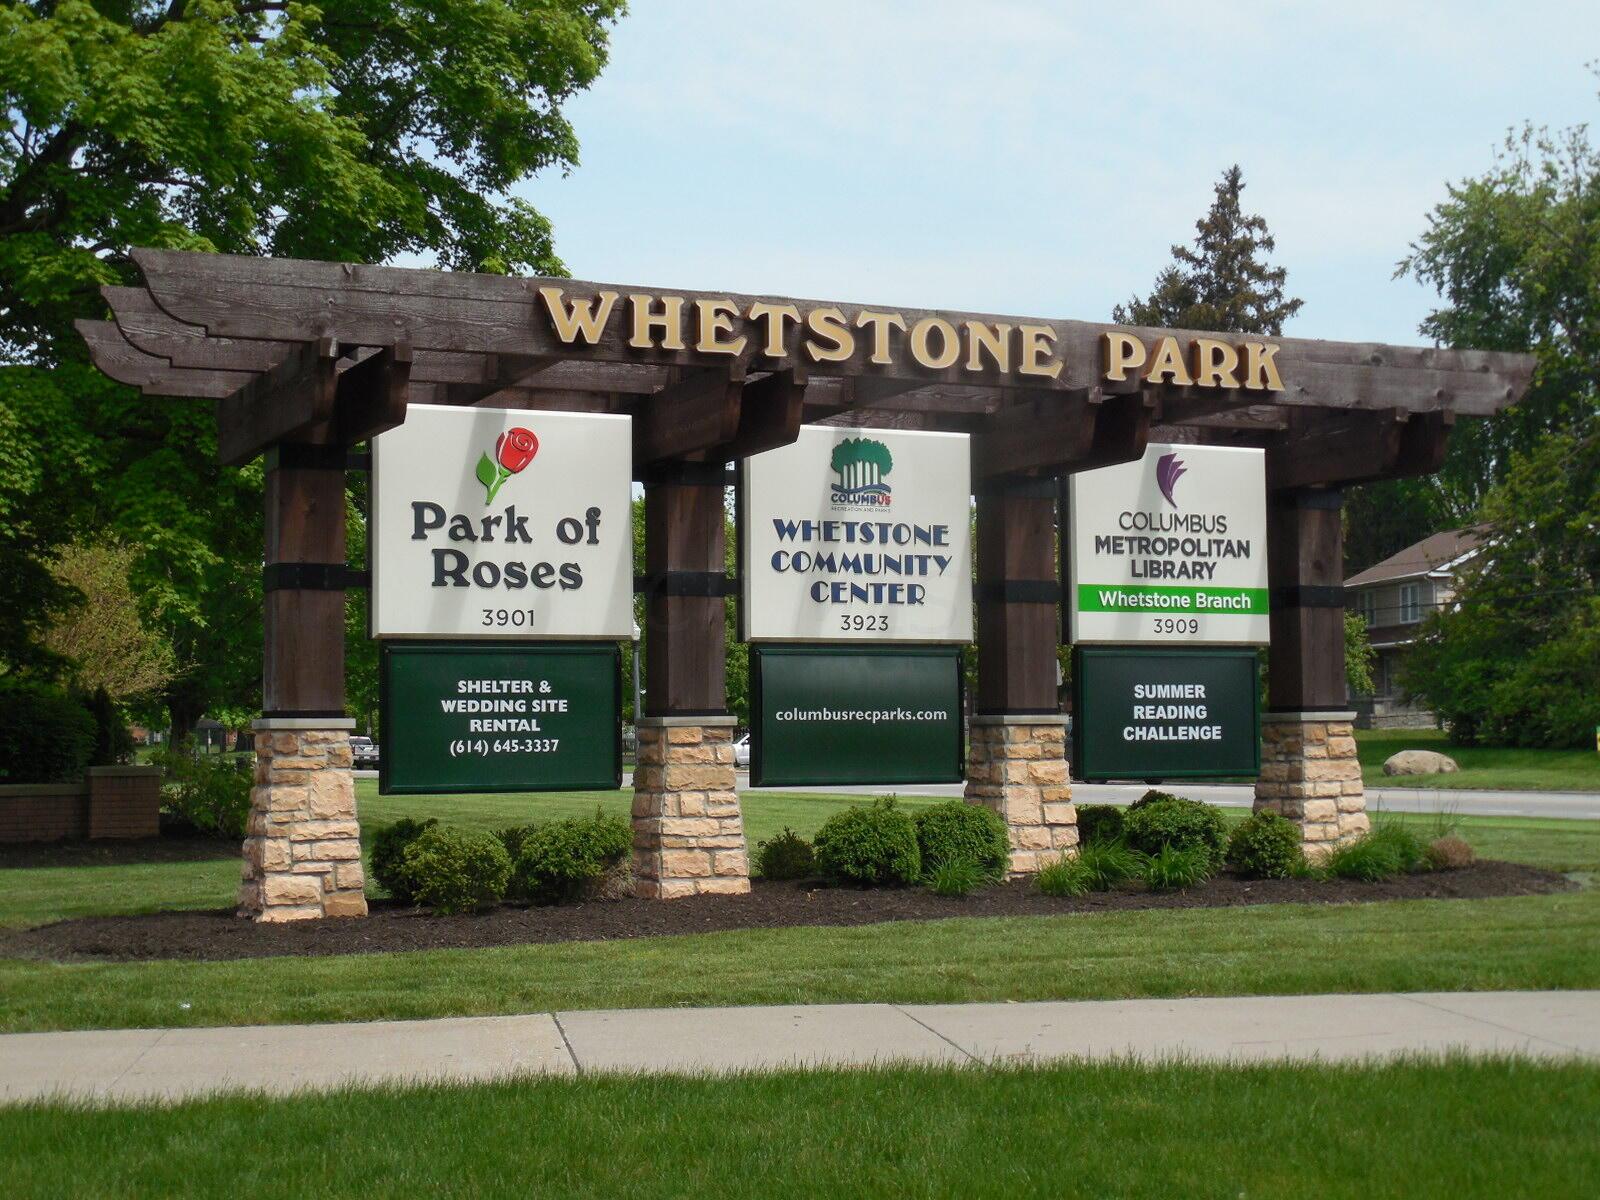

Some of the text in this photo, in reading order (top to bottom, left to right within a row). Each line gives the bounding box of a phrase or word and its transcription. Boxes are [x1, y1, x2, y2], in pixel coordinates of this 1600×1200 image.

[538, 287, 1286, 392] WHETSTONE PARK
[830, 493, 892, 506] COLUMBUS
[411, 500, 602, 545] Park of
[1118, 511, 1228, 535] COLUMBUS
[772, 518, 950, 547] WHETSTONE
[1094, 535, 1251, 559] METROPOLITAN
[431, 548, 584, 592] Roses
[770, 550, 953, 577] COMMUNITY
[1131, 559, 1218, 580] LIBRARY
[810, 580, 926, 605] CENTER
[1098, 590, 1252, 609] Whetstone Branch
[481, 608, 536, 627] 3901
[840, 614, 889, 632] 3923
[1153, 618, 1199, 634] 3909
[457, 679, 552, 694] SHELTER &
[1133, 684, 1207, 699] SUMMER
[440, 699, 568, 713] WEDDING SITE
[1133, 705, 1208, 720] READING
[775, 707, 948, 724] columbusrecparks.com
[469, 718, 541, 733] RENTAL
[1123, 725, 1222, 741] CHALLENGE
[449, 739, 560, 757] (614) 645-3337
